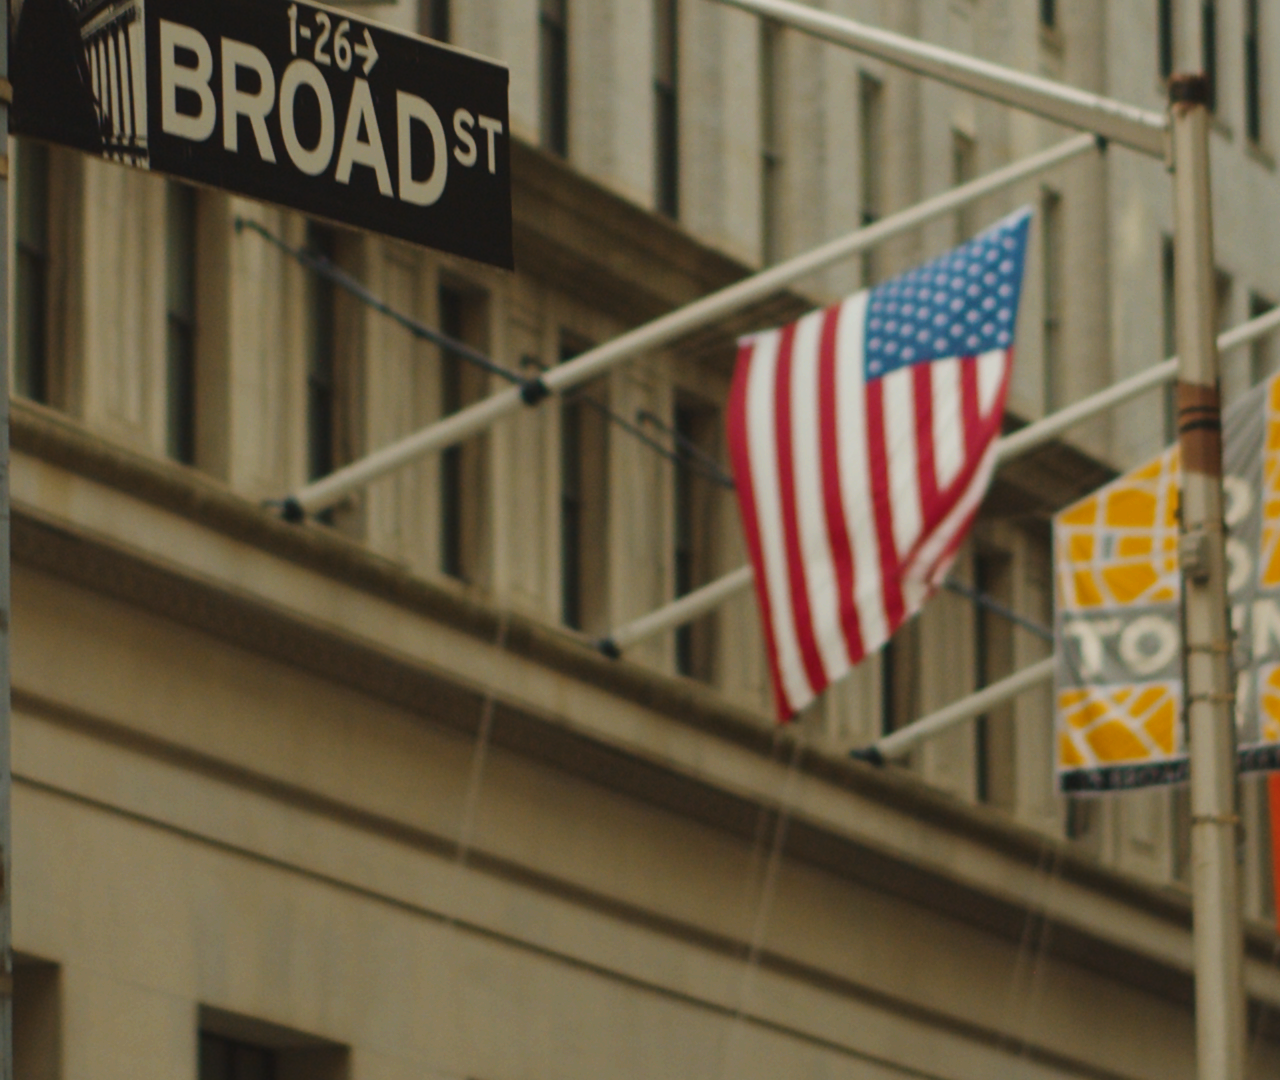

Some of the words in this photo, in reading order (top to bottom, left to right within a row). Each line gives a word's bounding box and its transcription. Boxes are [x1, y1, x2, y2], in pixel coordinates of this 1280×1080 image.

[287, 4, 352, 71] 1-26
[159, 18, 448, 206] BROAD
[453, 107, 502, 174] ST
